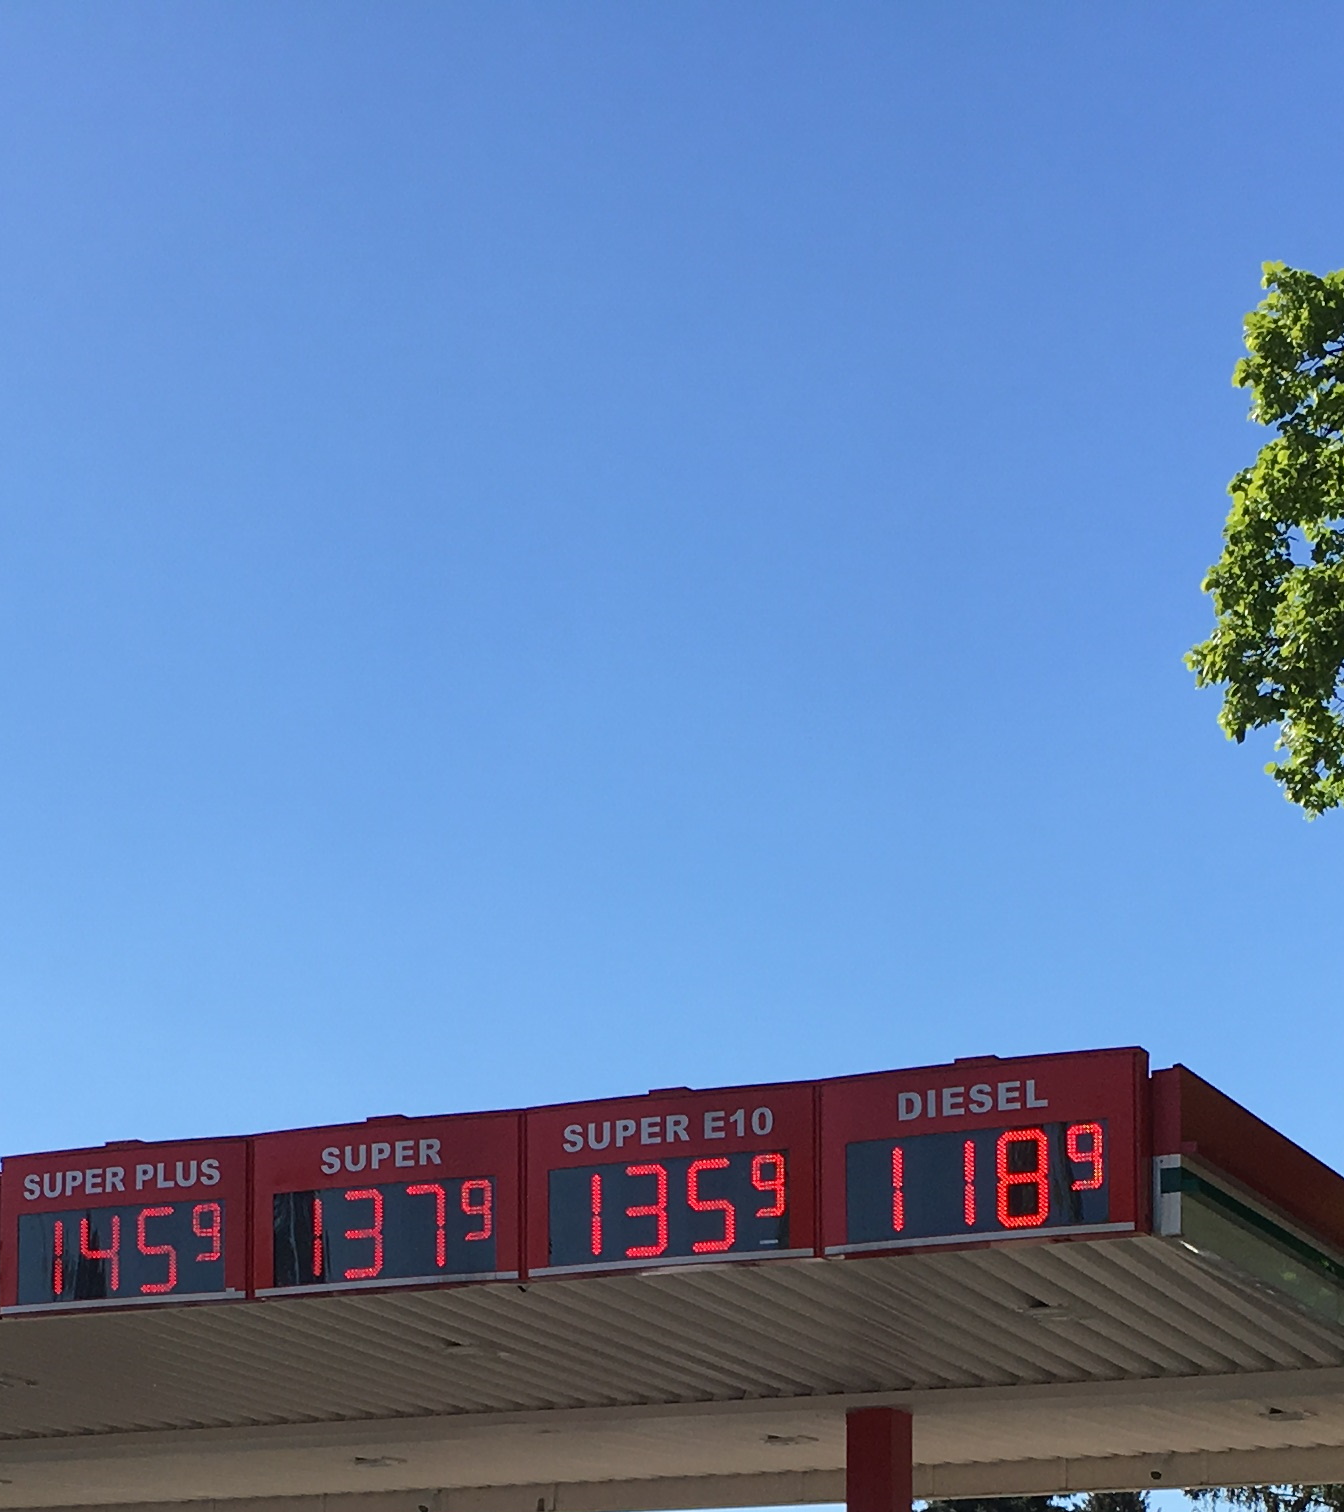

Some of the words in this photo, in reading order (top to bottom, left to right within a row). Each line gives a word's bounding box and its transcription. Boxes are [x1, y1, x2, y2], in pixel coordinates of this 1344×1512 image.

[897, 1079, 1049, 1121] DIESEL
[562, 1112, 689, 1153] SUPER
[703, 1106, 774, 1140] E10
[320, 1138, 442, 1175] SUPER
[23, 1166, 126, 1201] SUPER
[134, 1157, 222, 1191] PLUS
